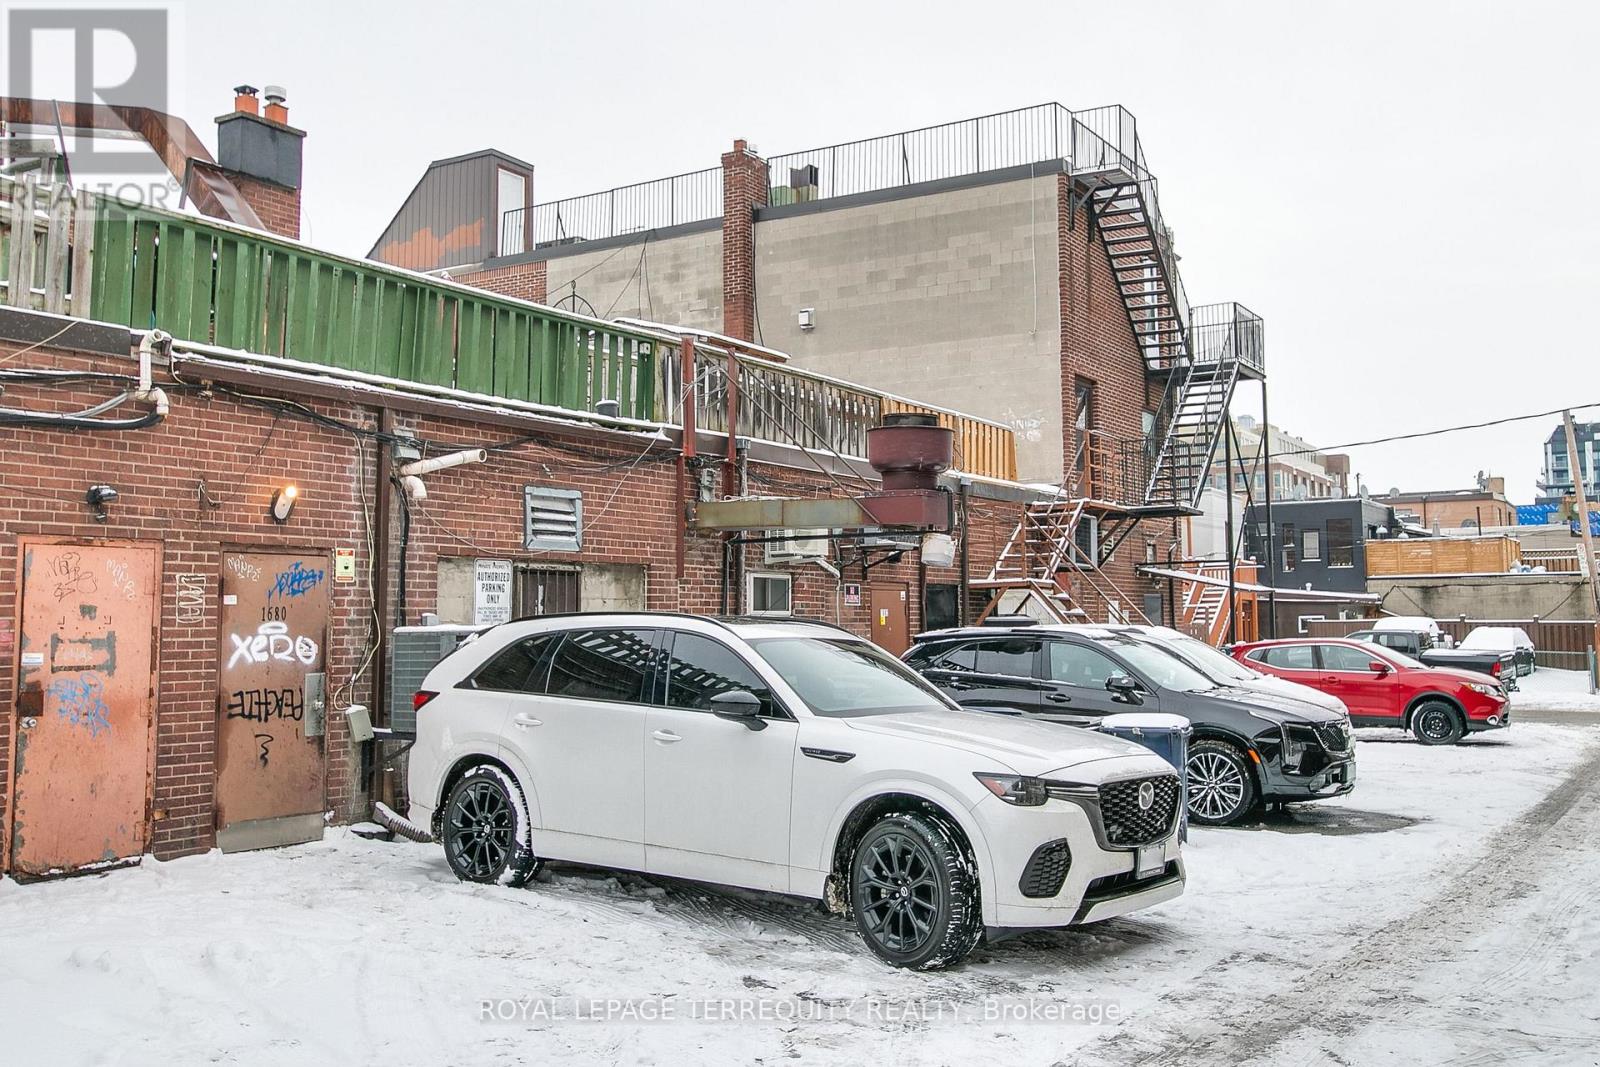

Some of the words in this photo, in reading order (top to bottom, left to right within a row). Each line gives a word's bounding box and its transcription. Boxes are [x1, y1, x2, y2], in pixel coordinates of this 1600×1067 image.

[477, 571, 510, 582] AUTHORIZED
[481, 583, 506, 593] PARKING
[487, 594, 501, 604] ONLY
[261, 606, 287, 622] 1680
